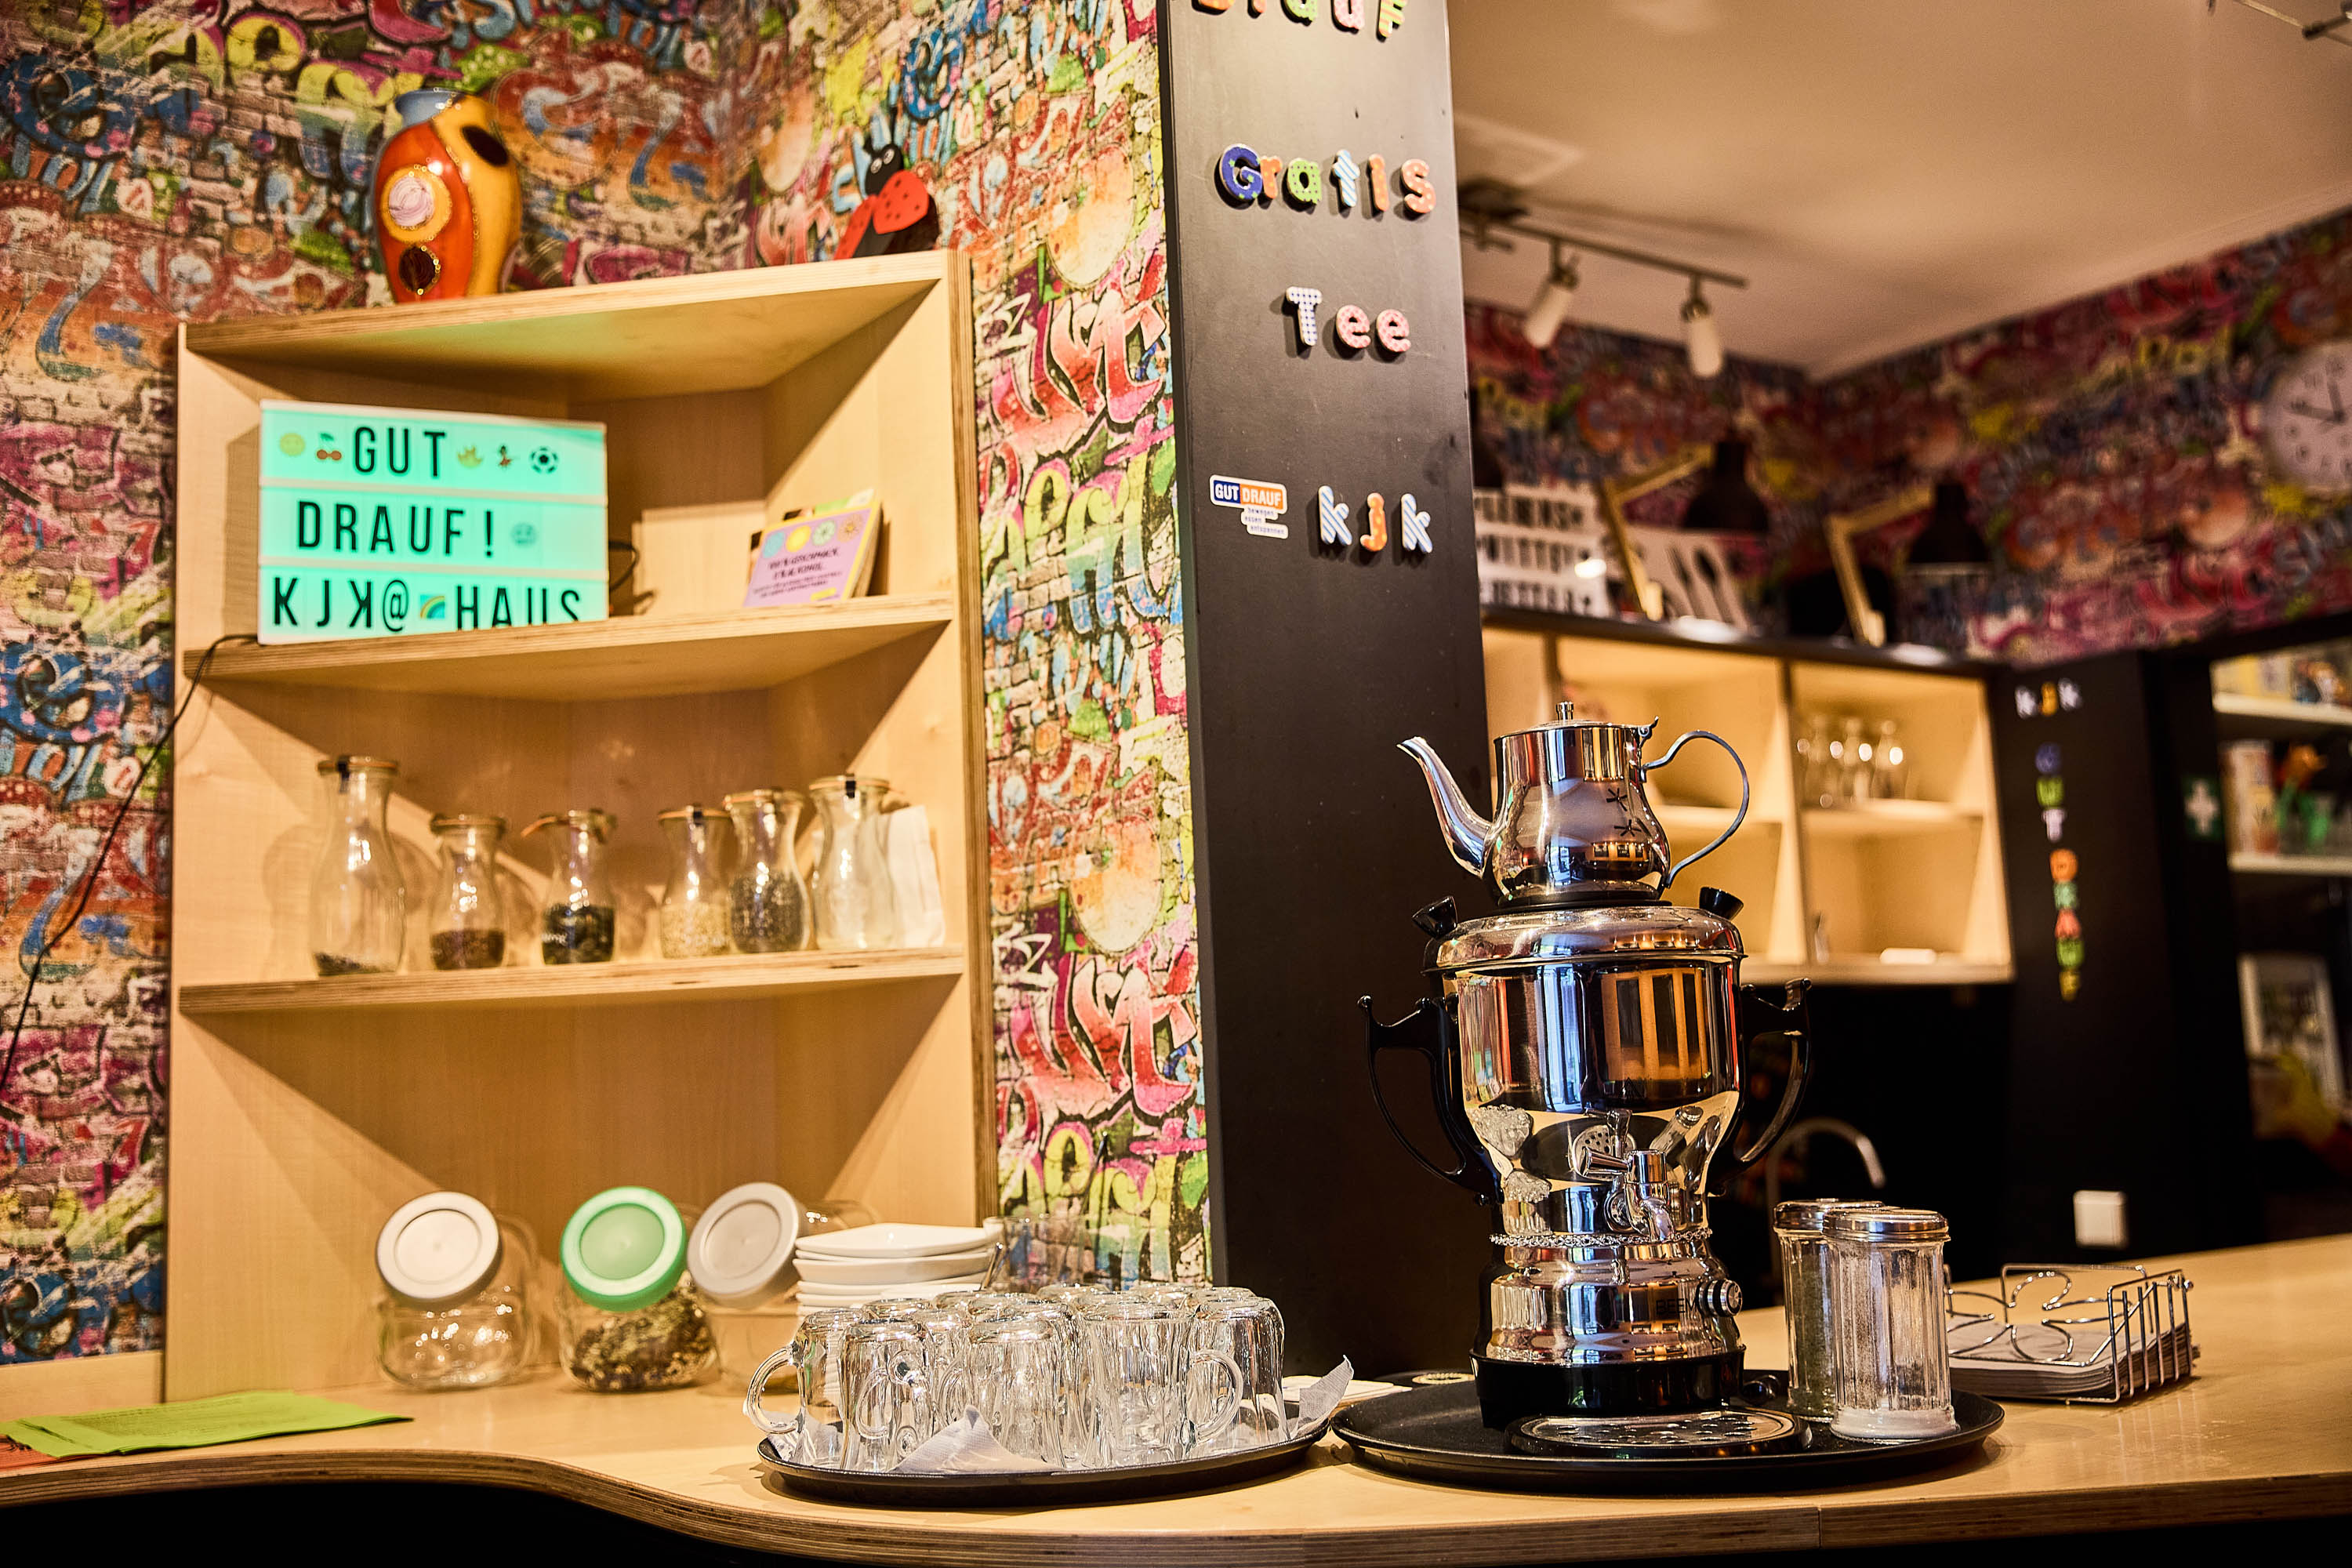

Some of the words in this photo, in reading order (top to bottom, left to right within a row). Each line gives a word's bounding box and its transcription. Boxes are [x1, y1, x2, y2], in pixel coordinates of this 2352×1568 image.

[1285, 285, 1411, 353] Tee
[354, 426, 447, 477] GUT
[1214, 483, 1240, 501] GUT
[1242, 487, 1282, 506] DRAUF
[297, 499, 494, 558] DRAUF!
